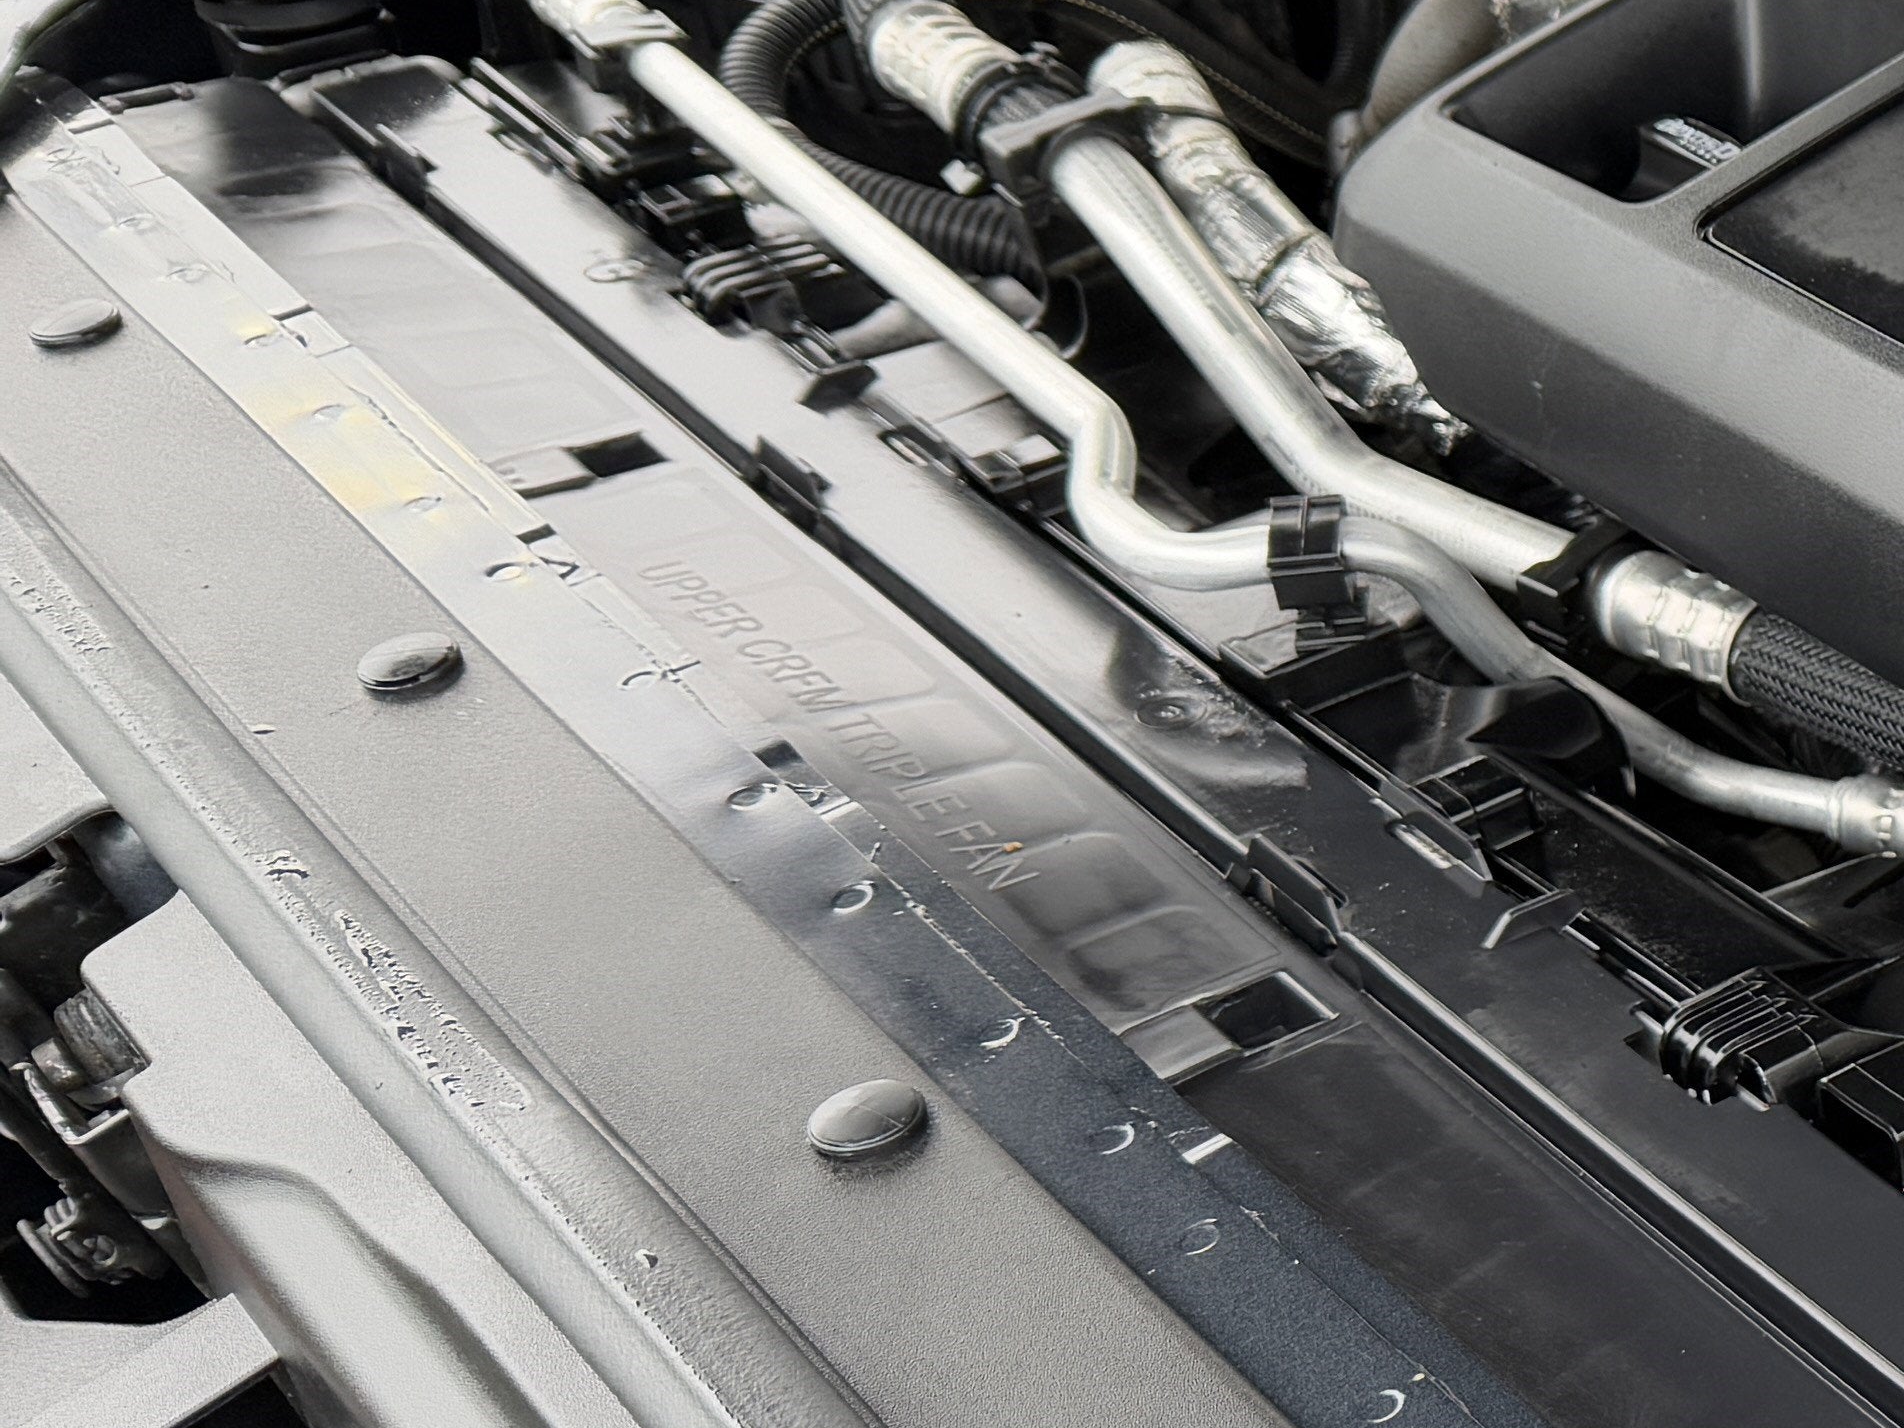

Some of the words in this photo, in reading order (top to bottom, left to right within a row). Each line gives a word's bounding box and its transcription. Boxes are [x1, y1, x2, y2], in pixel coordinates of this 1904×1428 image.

[639, 560, 763, 639] UPPER
[736, 639, 857, 713] CRFM
[827, 713, 971, 821] TRIPLE
[934, 820, 1040, 891] FAN
